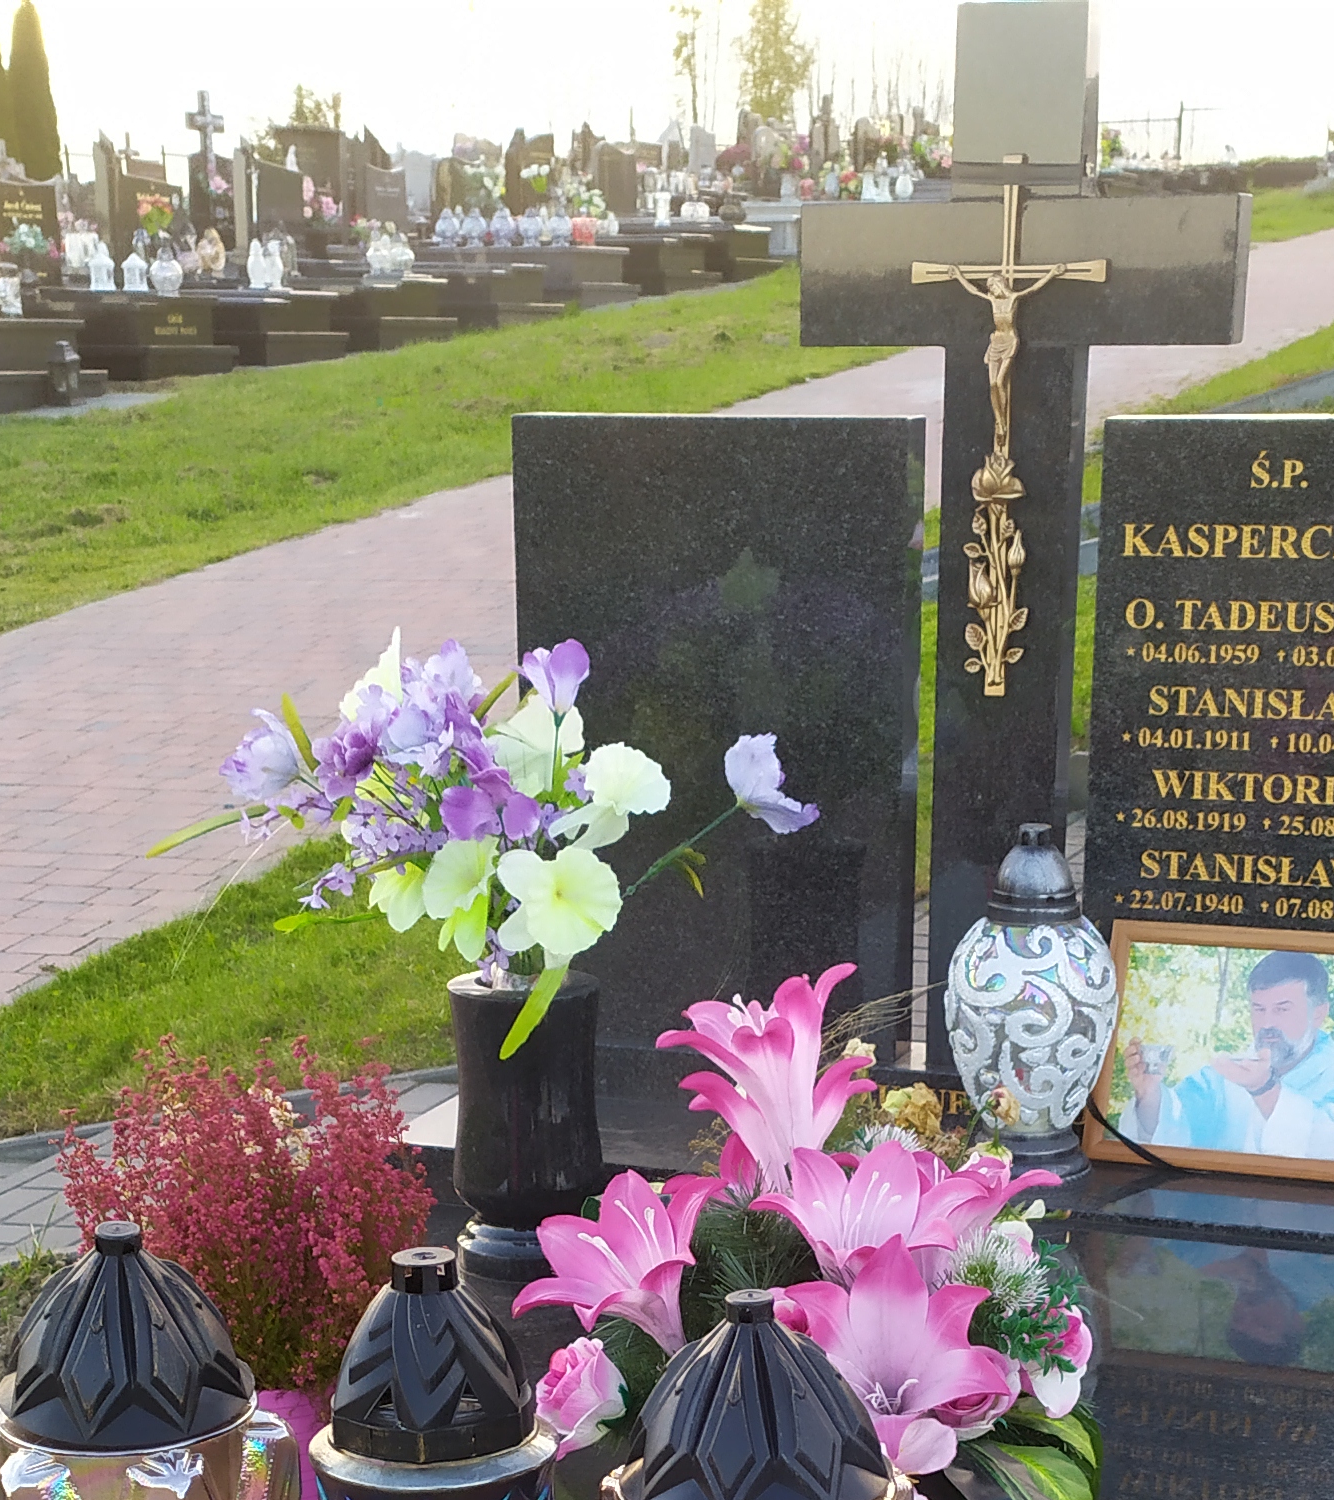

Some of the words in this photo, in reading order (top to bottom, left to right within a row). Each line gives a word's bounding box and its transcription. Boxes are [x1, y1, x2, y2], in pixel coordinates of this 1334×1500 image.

[1250, 450, 1309, 489] Ś.P.
[1124, 598, 1165, 630] O.
[1141, 642, 1261, 665] 04.06.1959
[1137, 727, 1251, 751] 04.01.1911
[1130, 807, 1247, 833] 26.08.1919
[1128, 889, 1245, 914] 22.07.1940
